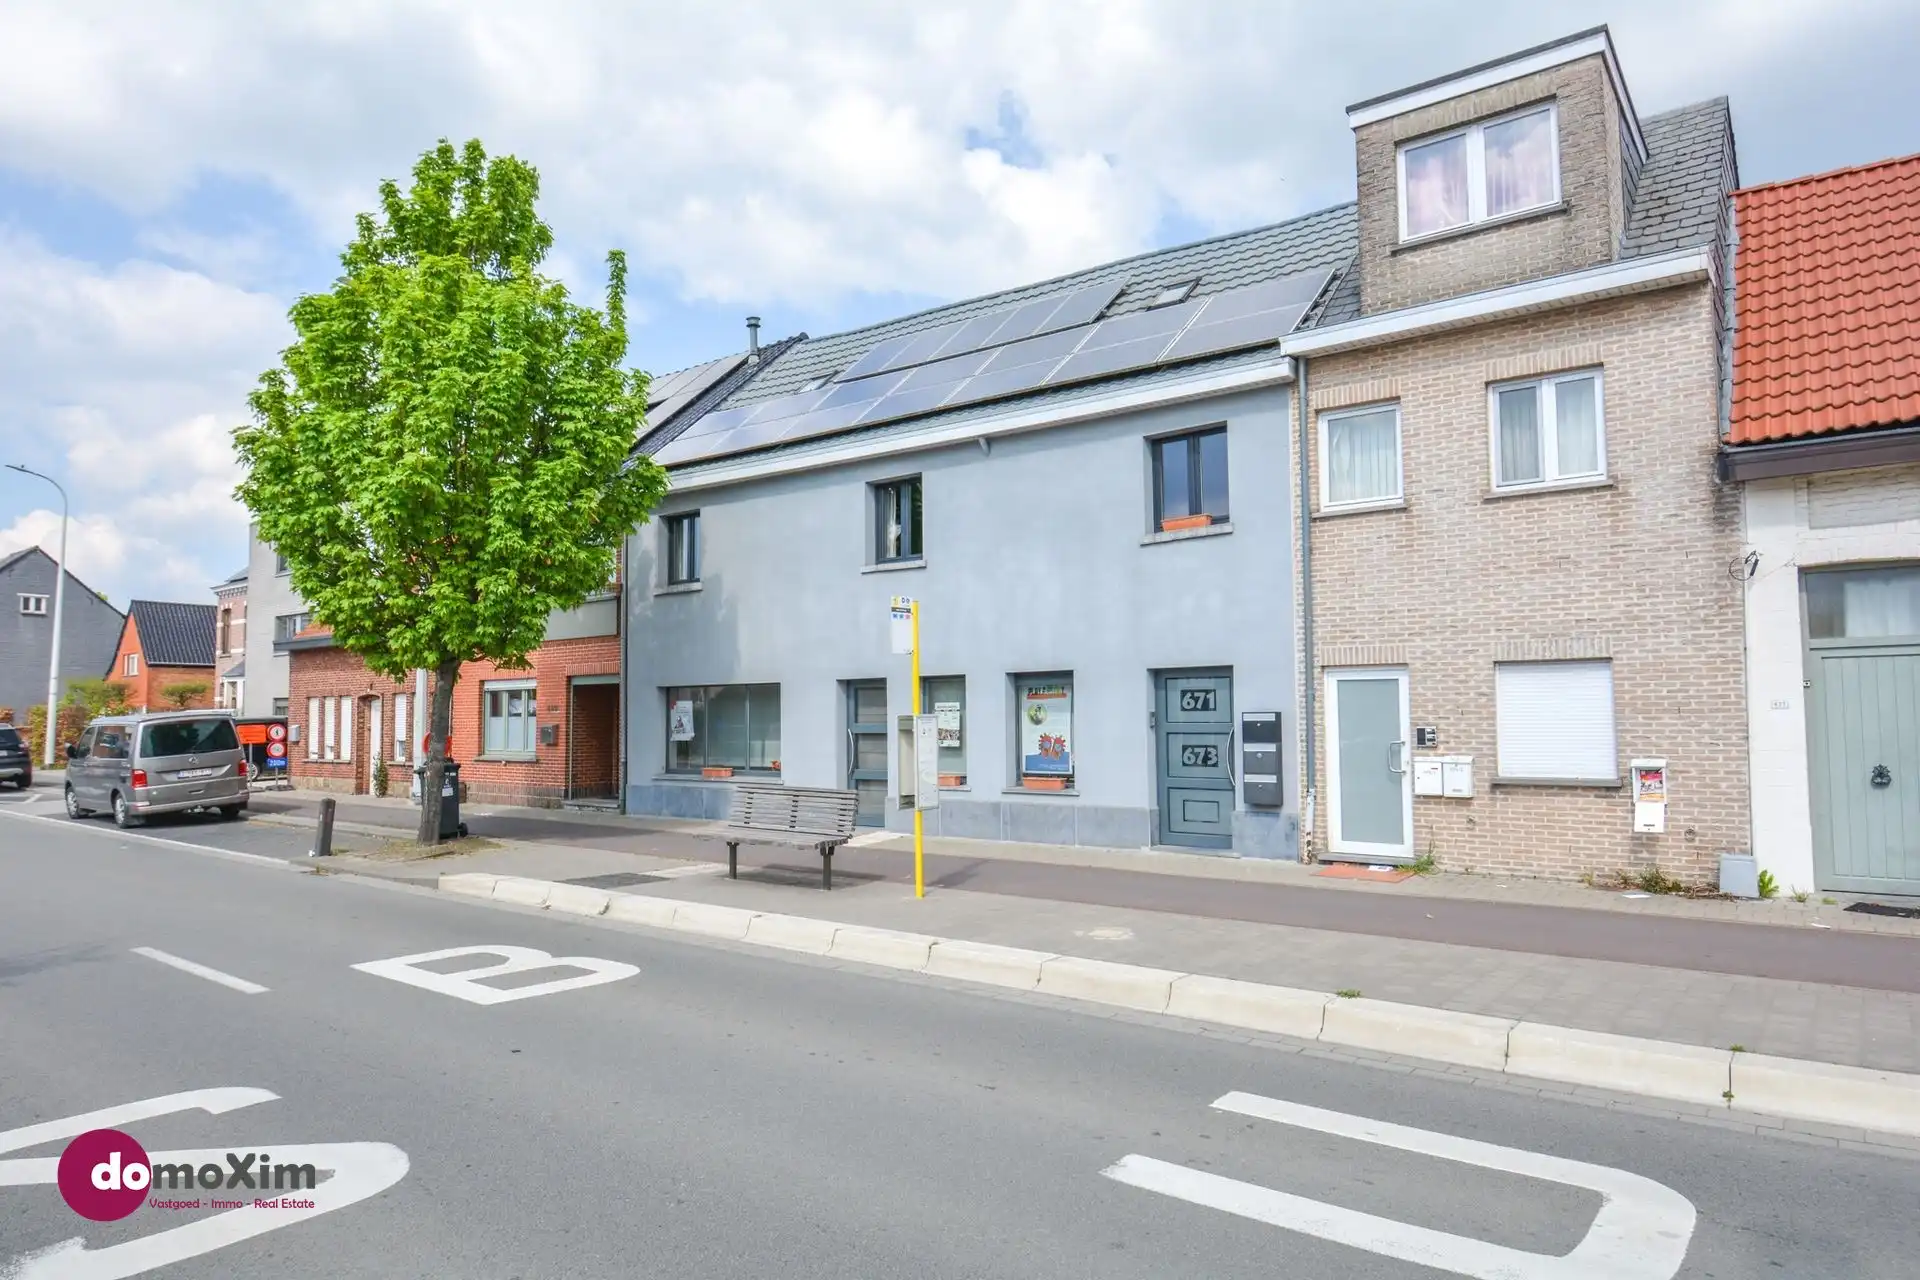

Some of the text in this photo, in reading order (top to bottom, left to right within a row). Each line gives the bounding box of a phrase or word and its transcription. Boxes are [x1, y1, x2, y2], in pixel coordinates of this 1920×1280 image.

[1182, 692, 1215, 709] 671
[1183, 747, 1218, 765] 673
[349, 945, 641, 1006] B
